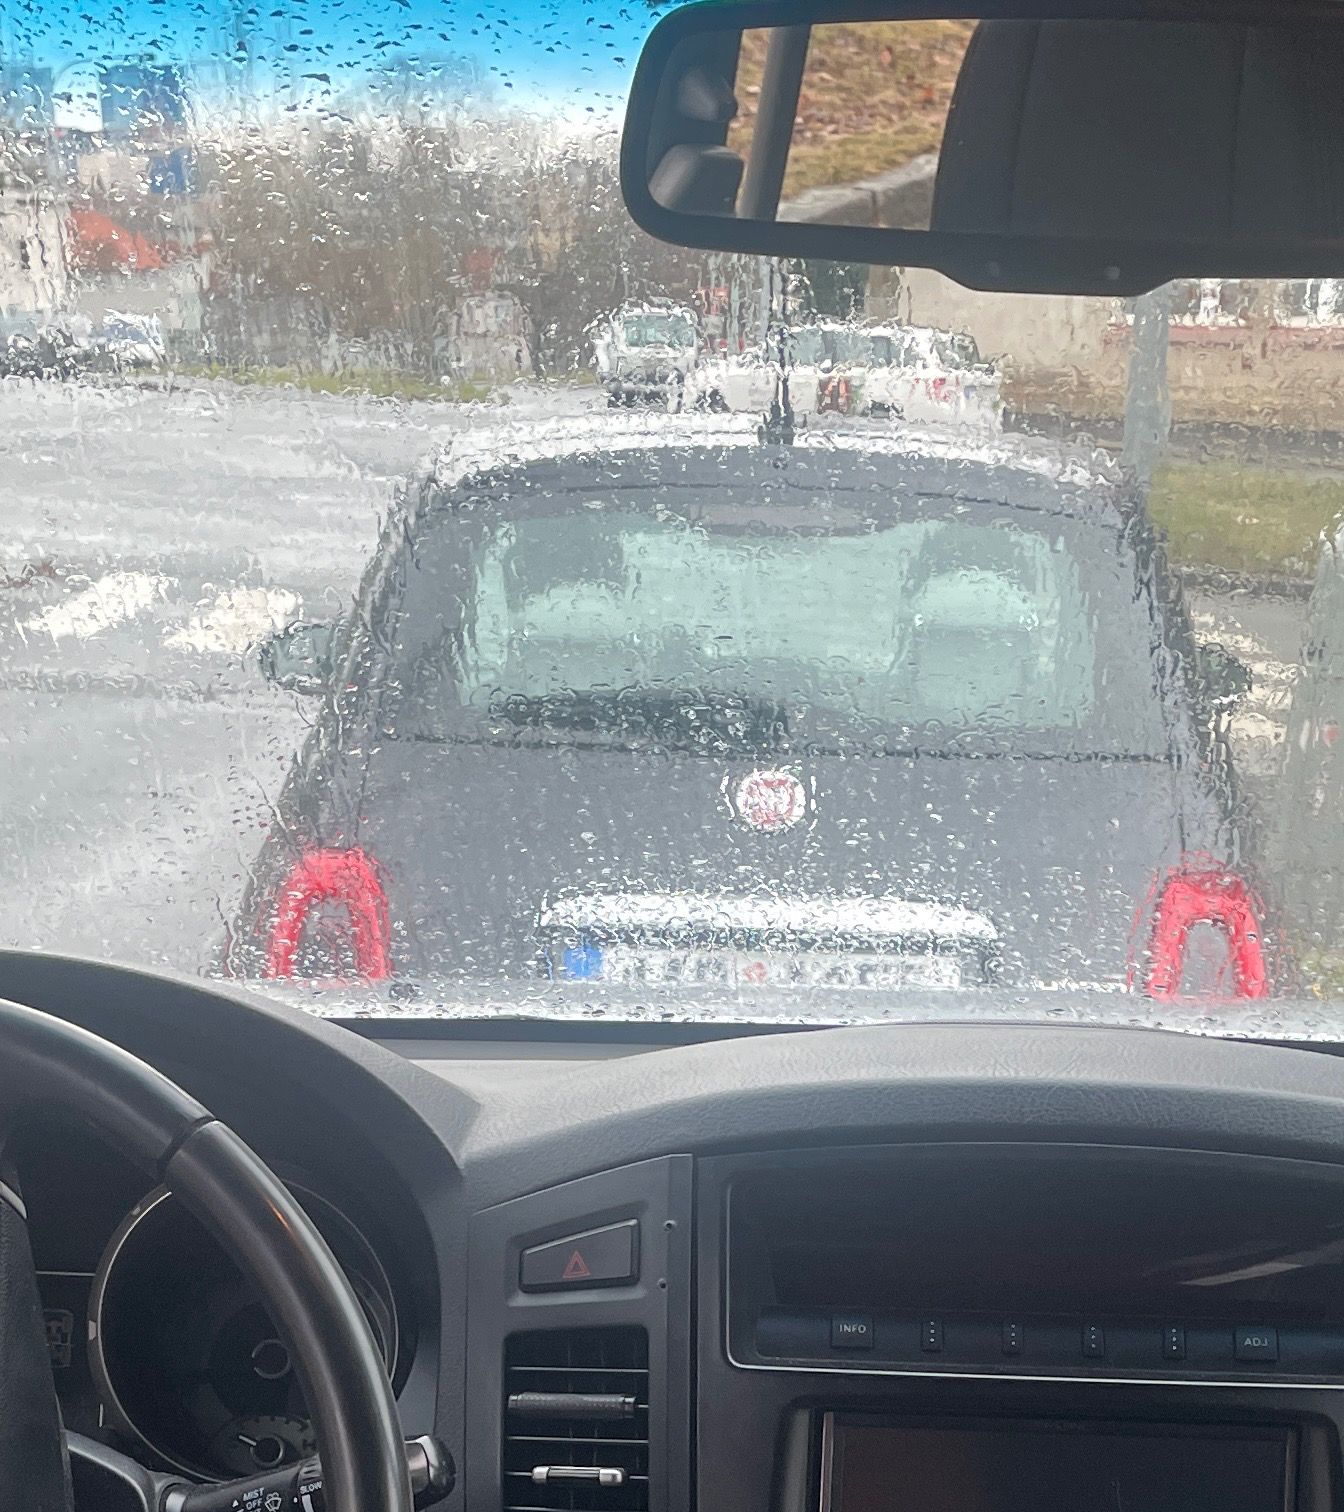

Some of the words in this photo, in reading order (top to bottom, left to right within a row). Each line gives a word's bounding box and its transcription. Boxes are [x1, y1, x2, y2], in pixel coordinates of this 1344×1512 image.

[839, 1323, 866, 1334] INFO
[1243, 1336, 1269, 1348] ADJ
[299, 1481, 323, 1494] SLOW
[243, 1487, 264, 1501] MIST
[246, 1498, 262, 1510] OFF
